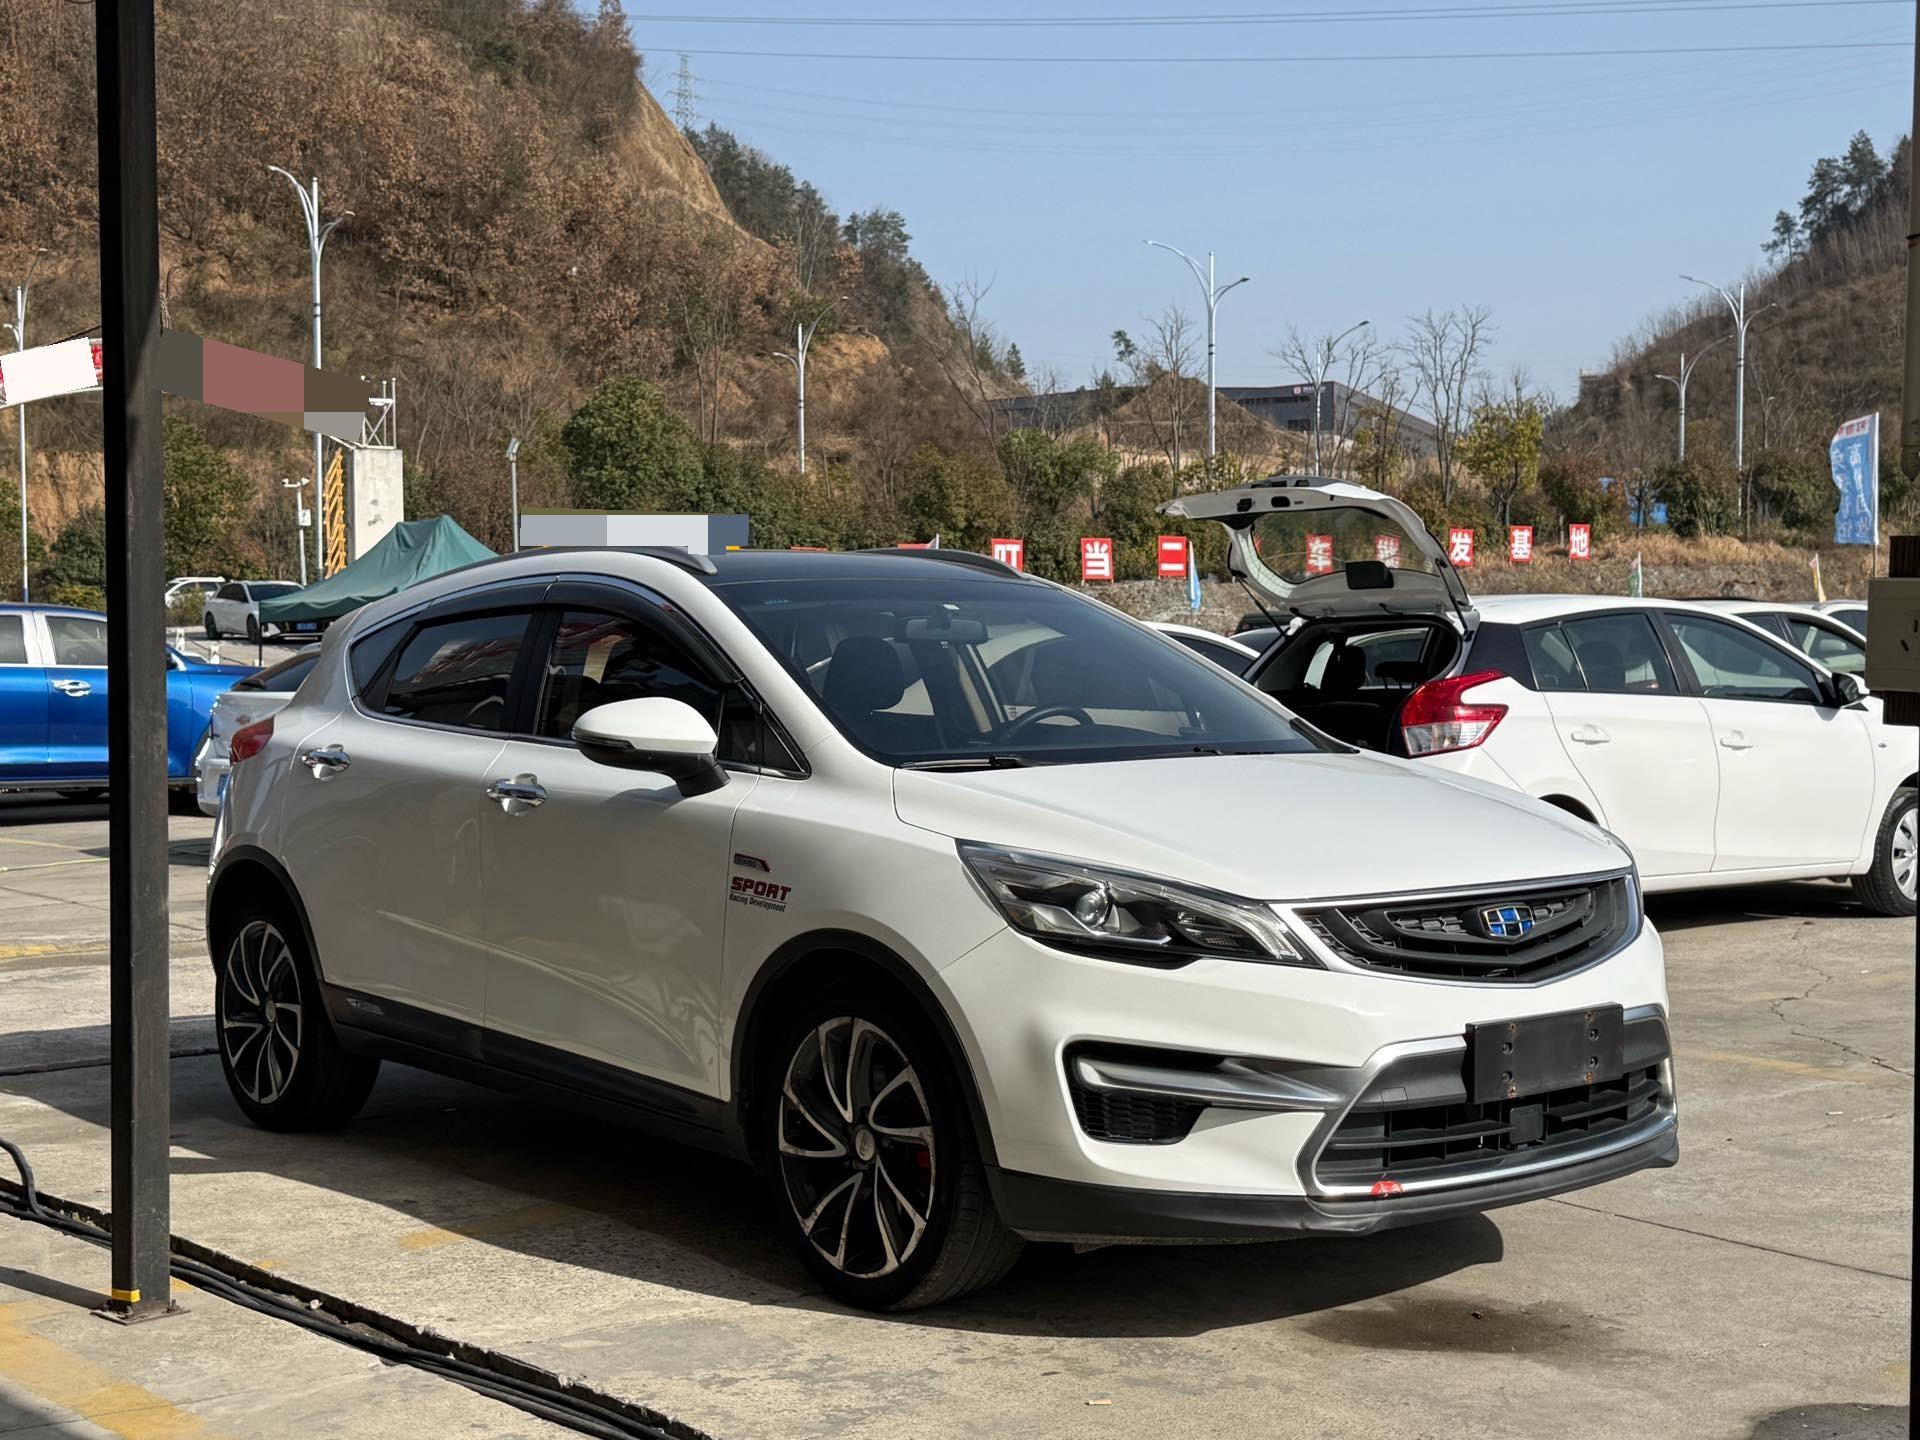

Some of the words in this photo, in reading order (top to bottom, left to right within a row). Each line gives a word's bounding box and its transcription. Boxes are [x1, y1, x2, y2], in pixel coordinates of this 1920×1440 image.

[1160, 542, 1184, 571] 二
[1451, 532, 1473, 563] 发
[1512, 529, 1531, 561] 基
[1570, 527, 1589, 557] 地
[1084, 541, 1110, 576] 当
[729, 893, 748, 905] Racing
[749, 897, 786, 912] Development
[731, 876, 792, 900] SPORT
